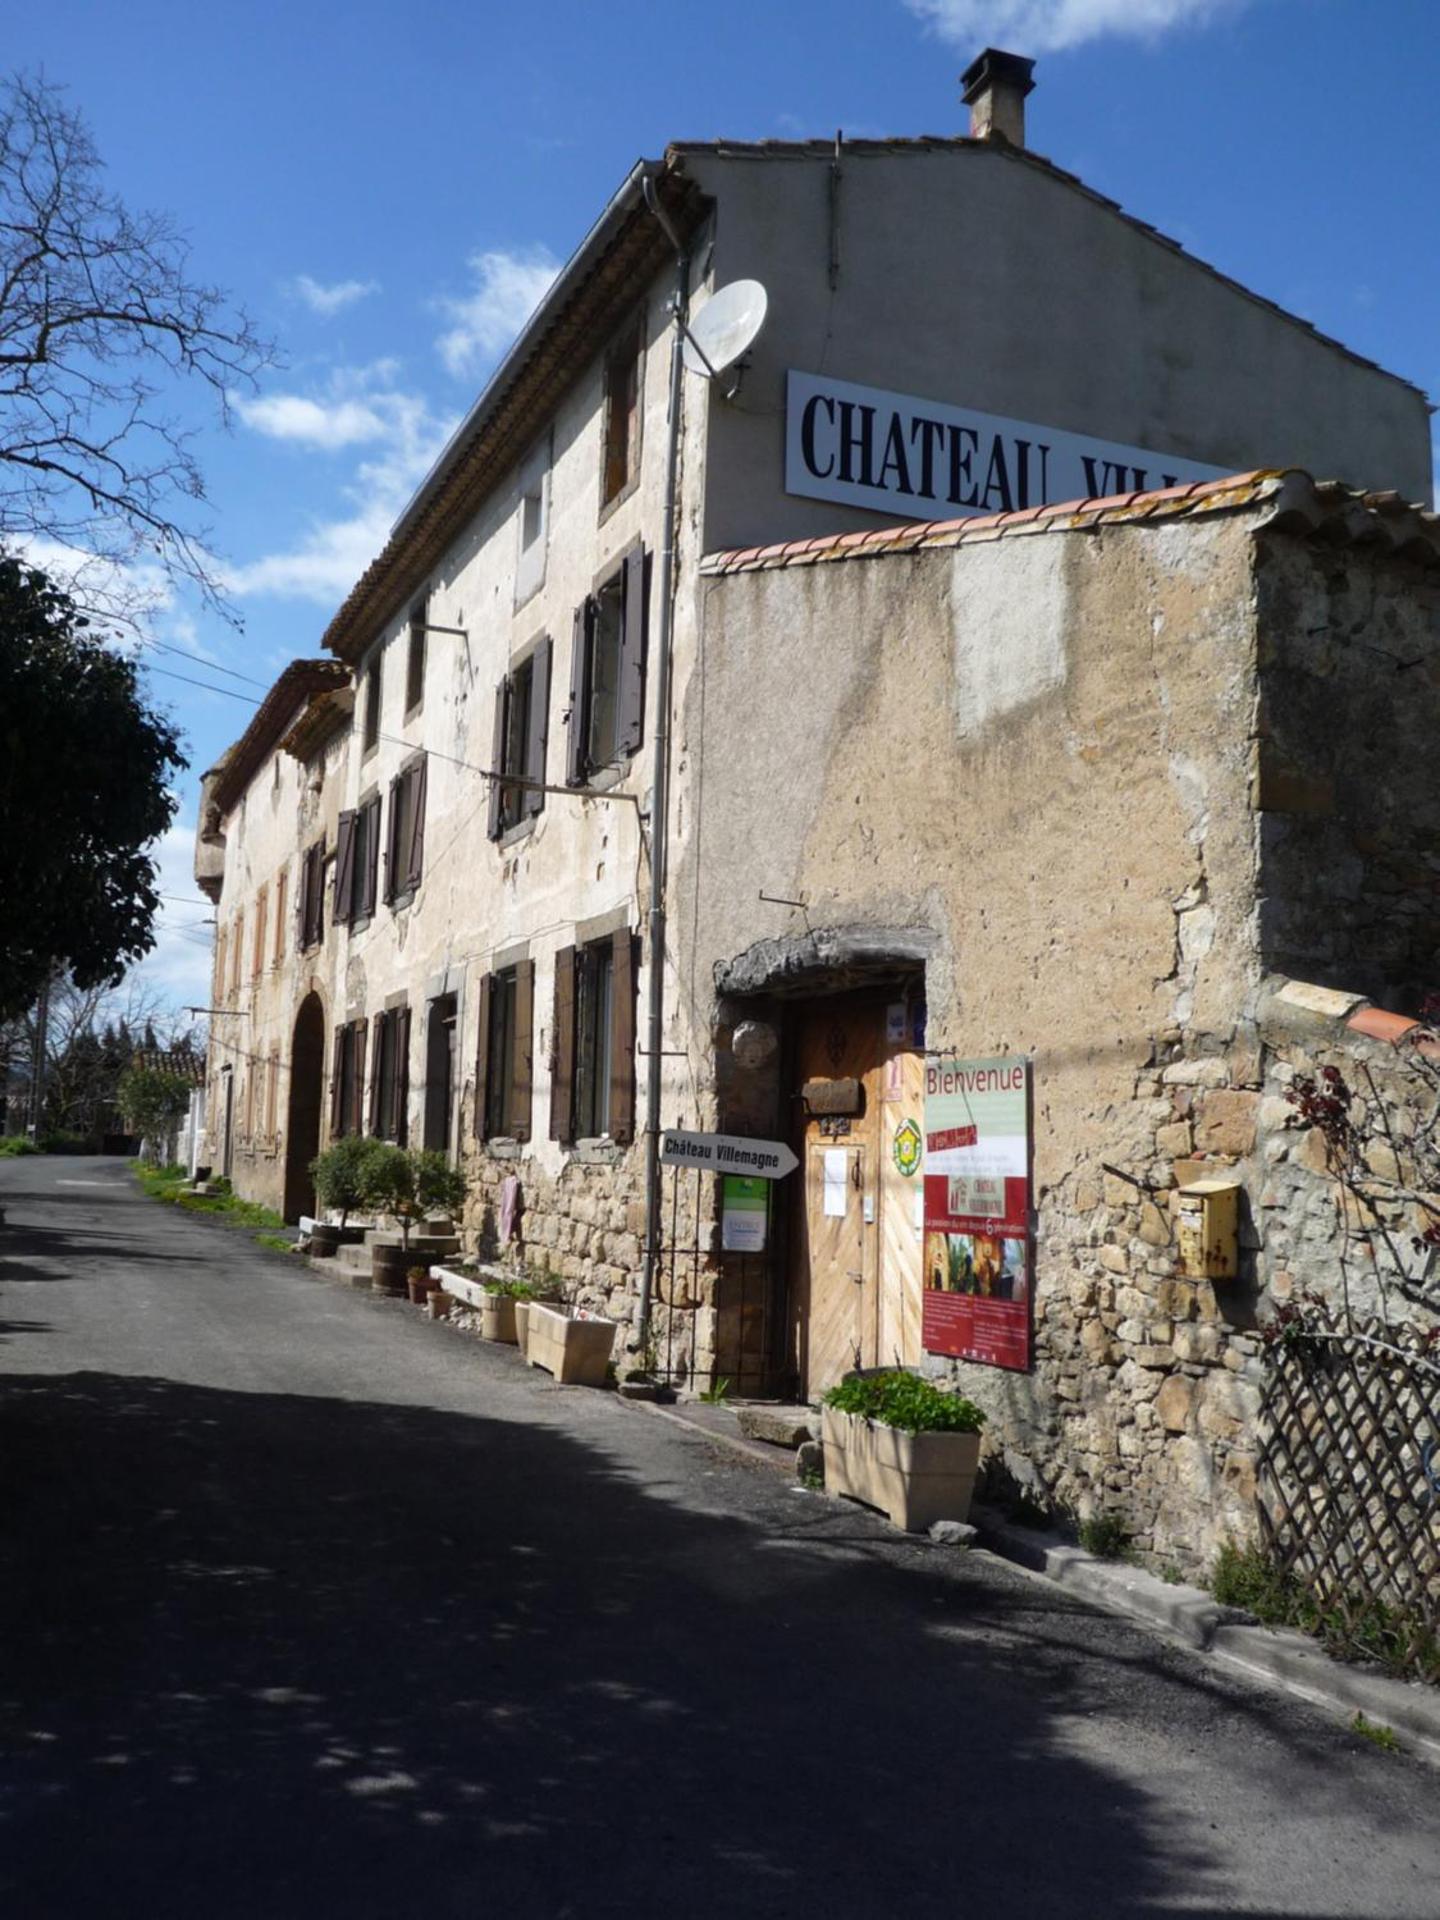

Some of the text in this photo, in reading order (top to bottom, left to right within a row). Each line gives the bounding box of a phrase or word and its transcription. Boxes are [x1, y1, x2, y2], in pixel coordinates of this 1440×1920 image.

[801, 394, 1050, 513] CHATEAU
[926, 1066, 1024, 1095] Bienvenue
[665, 1138, 780, 1170] Château Villemagne
[986, 1218, 994, 1235] 6
